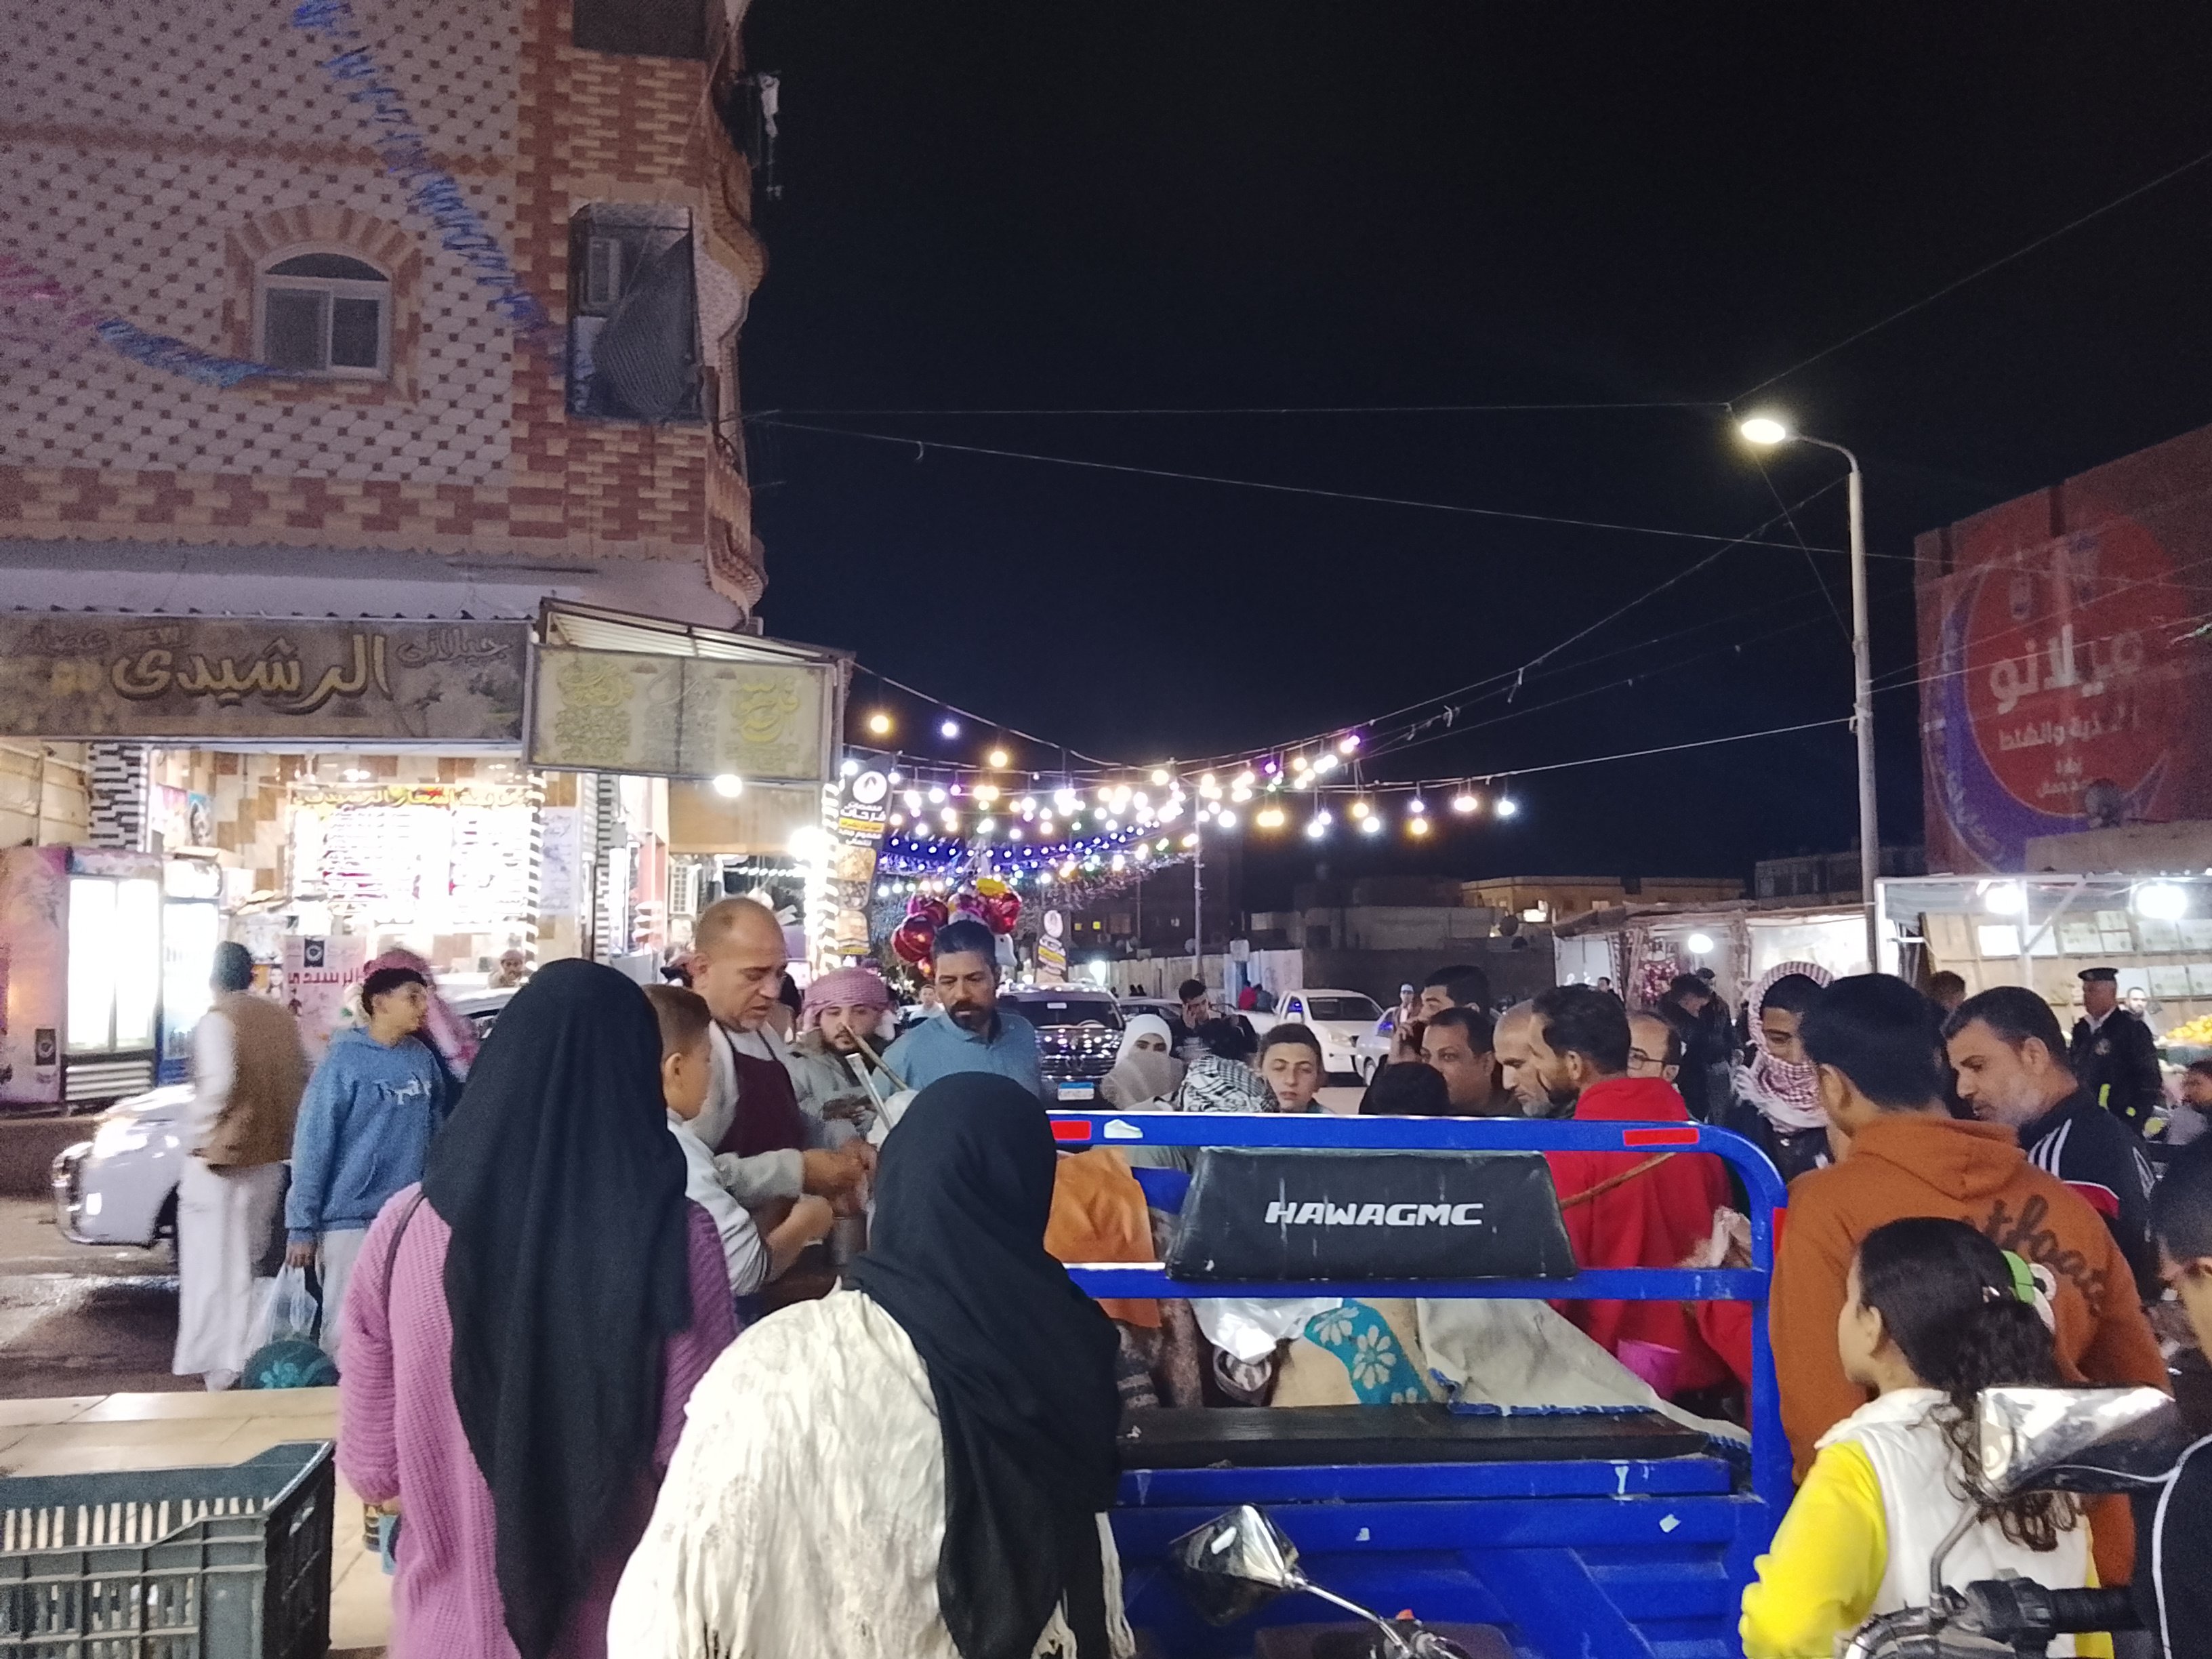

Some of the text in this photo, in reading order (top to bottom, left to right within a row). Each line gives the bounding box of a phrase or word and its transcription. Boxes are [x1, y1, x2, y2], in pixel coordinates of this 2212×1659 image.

[1990, 623, 2144, 714] ميلانو
[840, 808, 886, 822] فرحات
[1265, 1202, 1484, 1225] HAWAGMC
